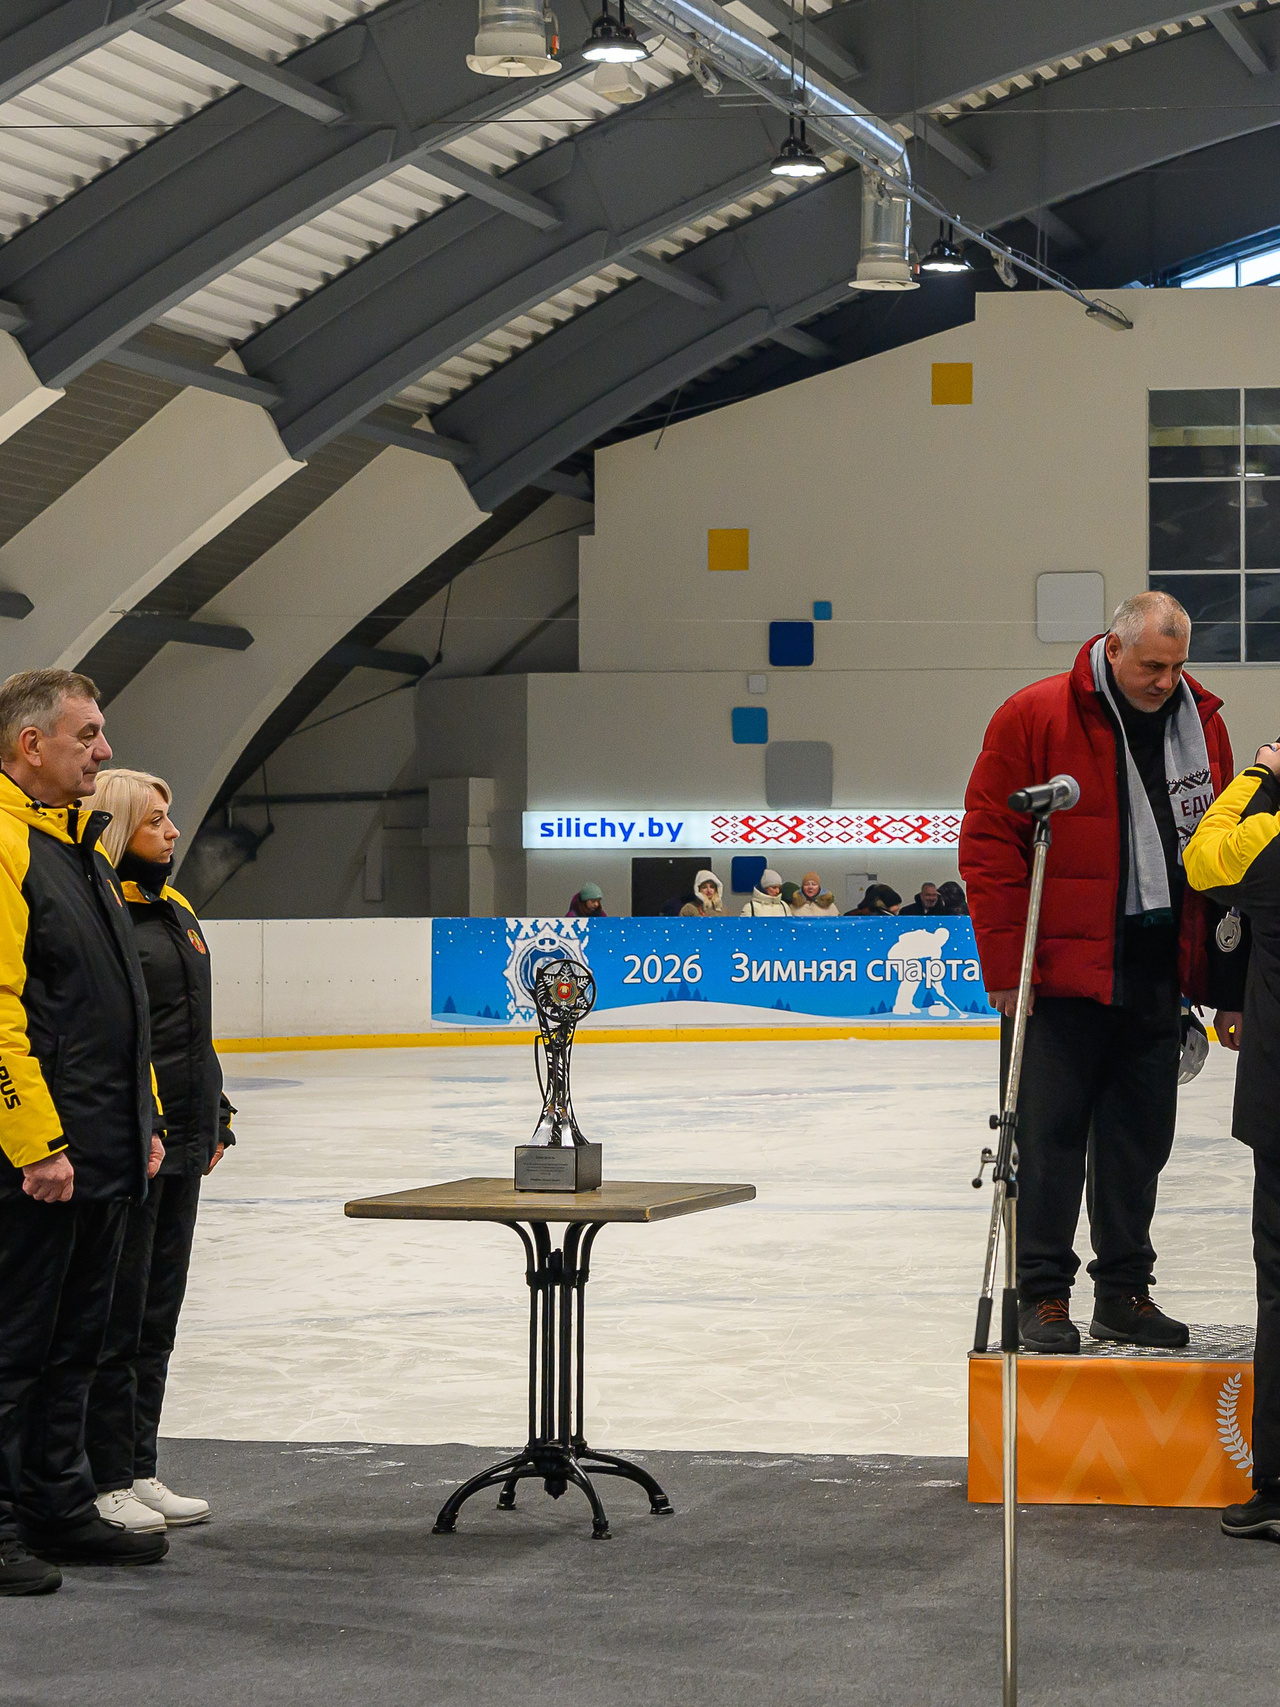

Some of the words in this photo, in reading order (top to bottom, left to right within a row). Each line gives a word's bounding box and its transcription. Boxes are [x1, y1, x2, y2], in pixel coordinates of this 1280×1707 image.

[540, 817, 684, 843] silichy.by
[622, 954, 703, 984] 2026
[730, 953, 858, 983] Зимняя
